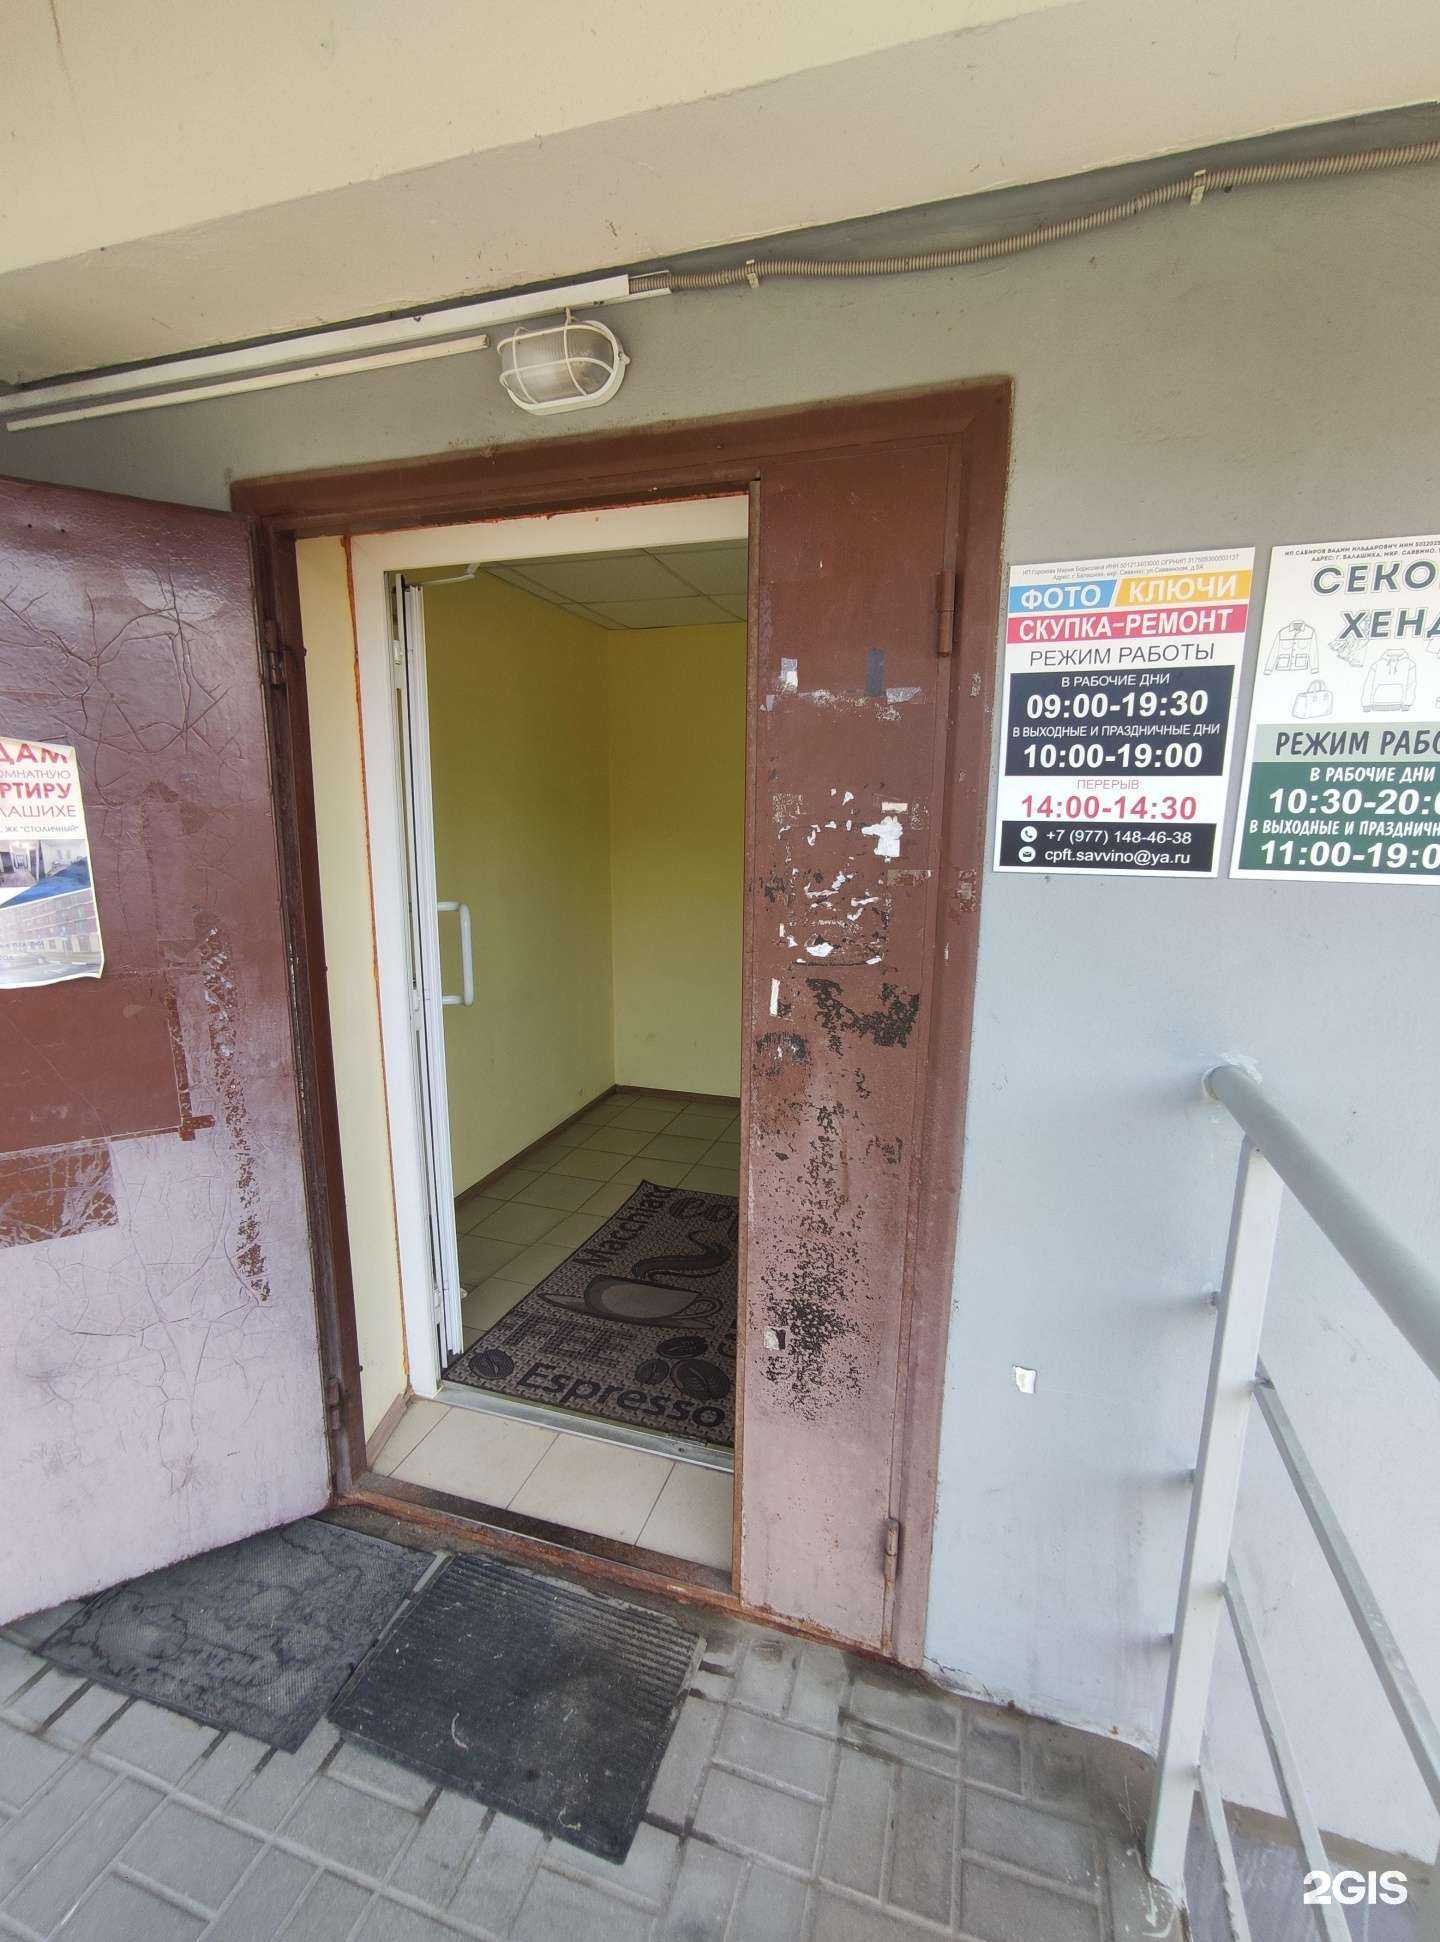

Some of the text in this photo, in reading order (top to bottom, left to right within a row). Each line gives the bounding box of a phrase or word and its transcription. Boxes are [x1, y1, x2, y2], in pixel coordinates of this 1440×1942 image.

[1021, 575, 1237, 610] ФОТО КЛЮЧИ
[1019, 608, 1233, 641] СКУПКА-РЕМОНТ
[1030, 643, 1214, 667] РЕЖИМ РАБОТЫ
[1061, 673, 1170, 688] В РАБОЧИЕ ДНИ
[1026, 690, 1208, 719] 09:00-19:30
[1012, 723, 1221, 738] В ВЫХОДНЫЕ И ПРАЗДНИЧНЫЕ ДНИ
[1275, 730, 1370, 756] РЕЖИМ
[1023, 743, 1203, 768] 10:00-19:00
[1077, 779, 1140, 790] ПЕРЕРЫВ
[1310, 766, 1436, 784] В РАБОЧИЕ ДНИ
[0, 782, 72, 799] РТИРУ
[1021, 795, 1198, 820] 14:00-14:30
[1046, 829, 1192, 844] +7 (977) 148-46-38
[1250, 819, 1258, 834] В
[1262, 819, 1340, 836] ВЫХОДНЫЕ
[1344, 820, 1354, 835] И
[1045, 848, 1191, 866] cpft.savvino@ya.ru
[517, 1362, 726, 1428] Espresso
